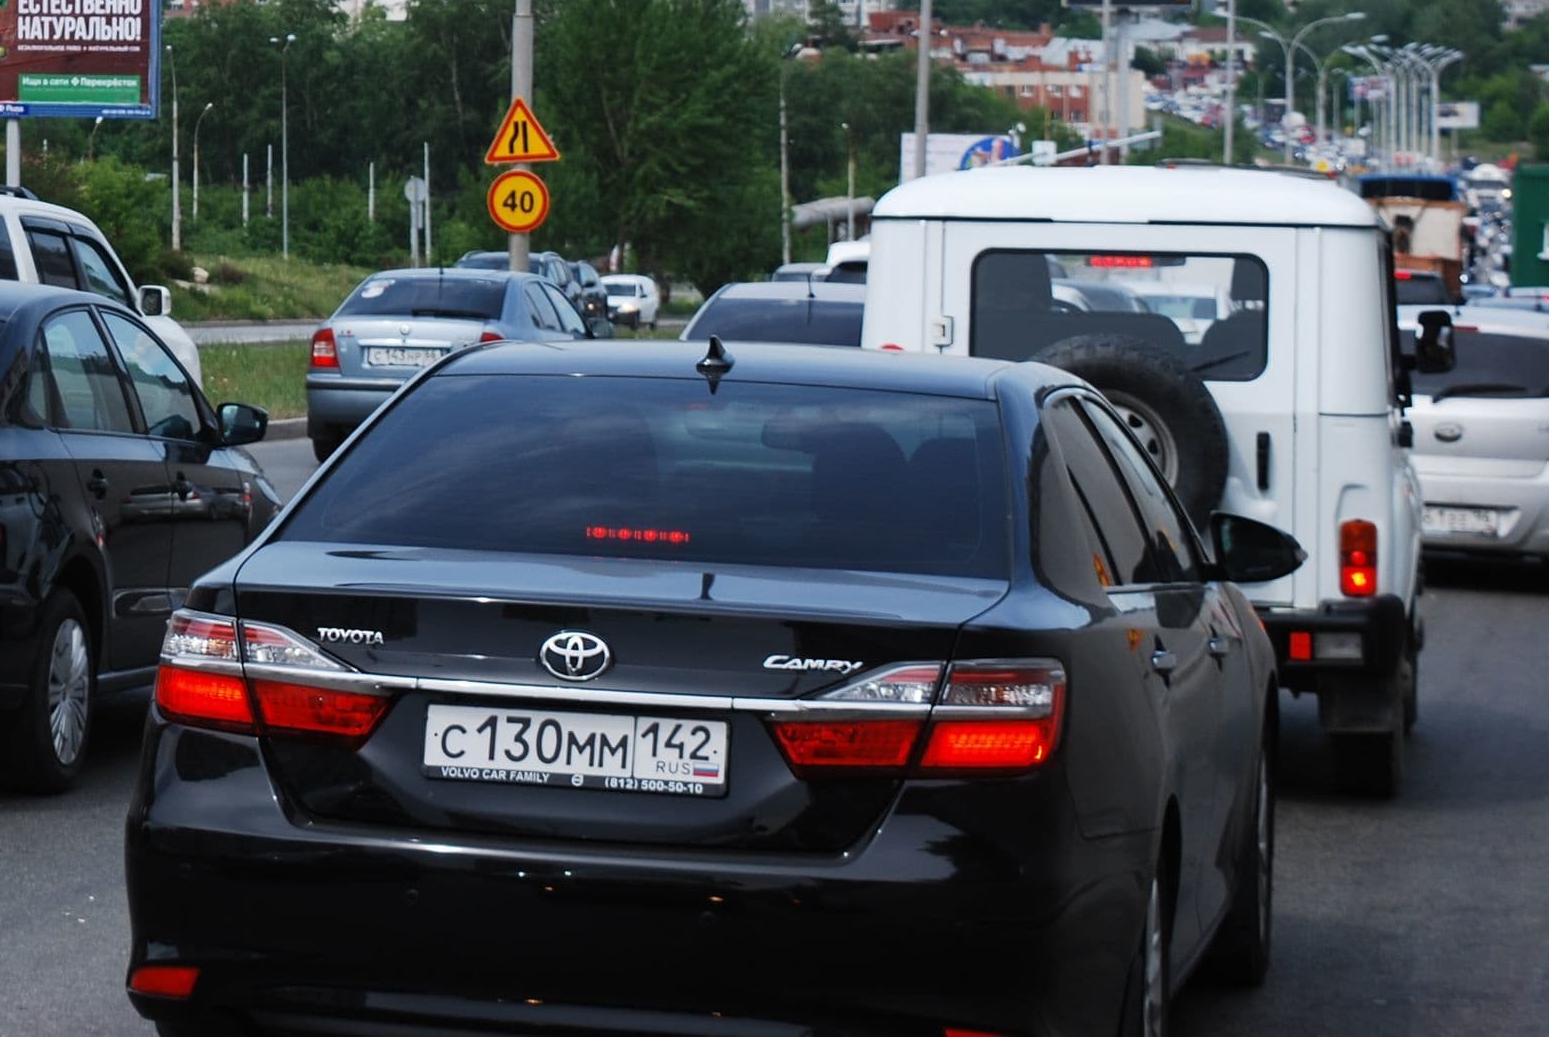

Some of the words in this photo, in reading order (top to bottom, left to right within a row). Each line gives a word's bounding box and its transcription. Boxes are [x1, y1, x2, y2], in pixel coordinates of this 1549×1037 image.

[17, 16, 142, 41] НАТУРАЛЬНО!
[22, 77, 41, 87] Ищи
[49, 78, 70, 86] сети
[80, 77, 138, 88] Перекрёсток
[502, 190, 535, 214] 40
[317, 626, 384, 647] TOYOTA
[440, 714, 629, 770] С130ММ
[640, 721, 712, 762] 142
[656, 760, 691, 776] RUS
[440, 766, 480, 780] VOLVO
[481, 770, 507, 782] CAR
[508, 771, 551, 784] FAMILY
[603, 775, 639, 790] (812)
[640, 778, 704, 795] 500-50-10
